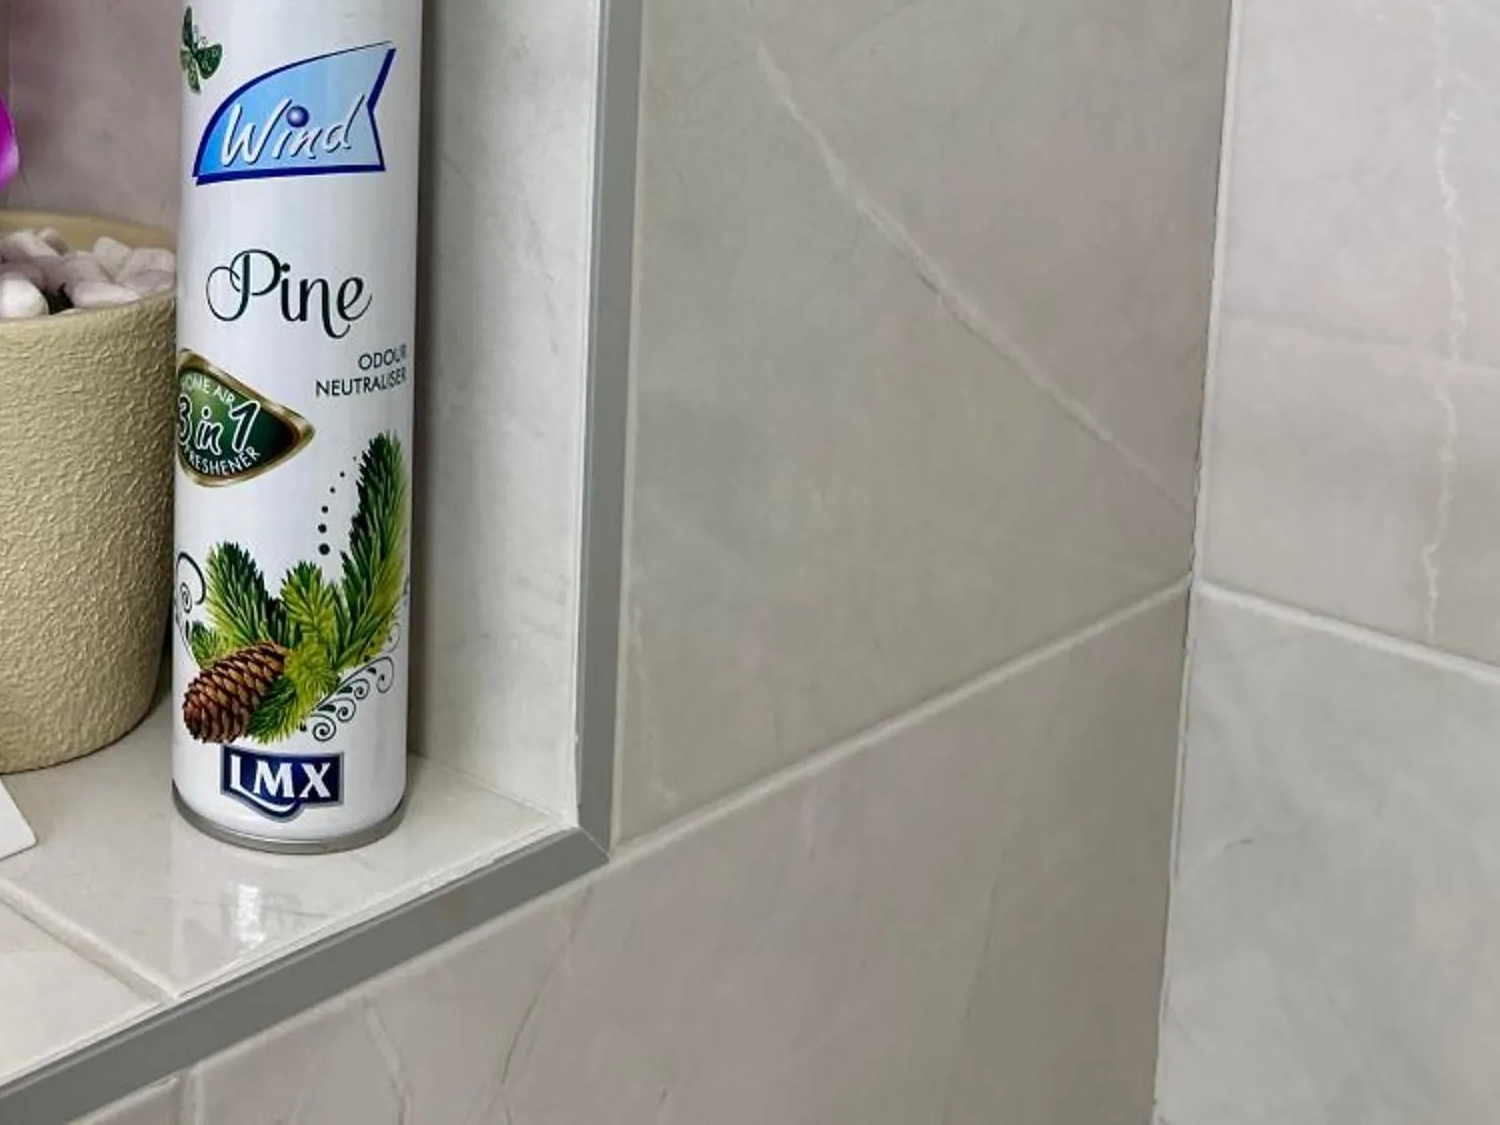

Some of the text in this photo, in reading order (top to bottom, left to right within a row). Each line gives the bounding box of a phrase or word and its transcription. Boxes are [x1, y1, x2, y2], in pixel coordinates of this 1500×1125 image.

[220, 92, 365, 167] Wind
[205, 248, 372, 339] Pine
[315, 366, 407, 398] NEUTRALISER
[358, 343, 407, 370] ODOUR
[178, 393, 261, 455] 3 in 1
[230, 755, 331, 812] LMX
